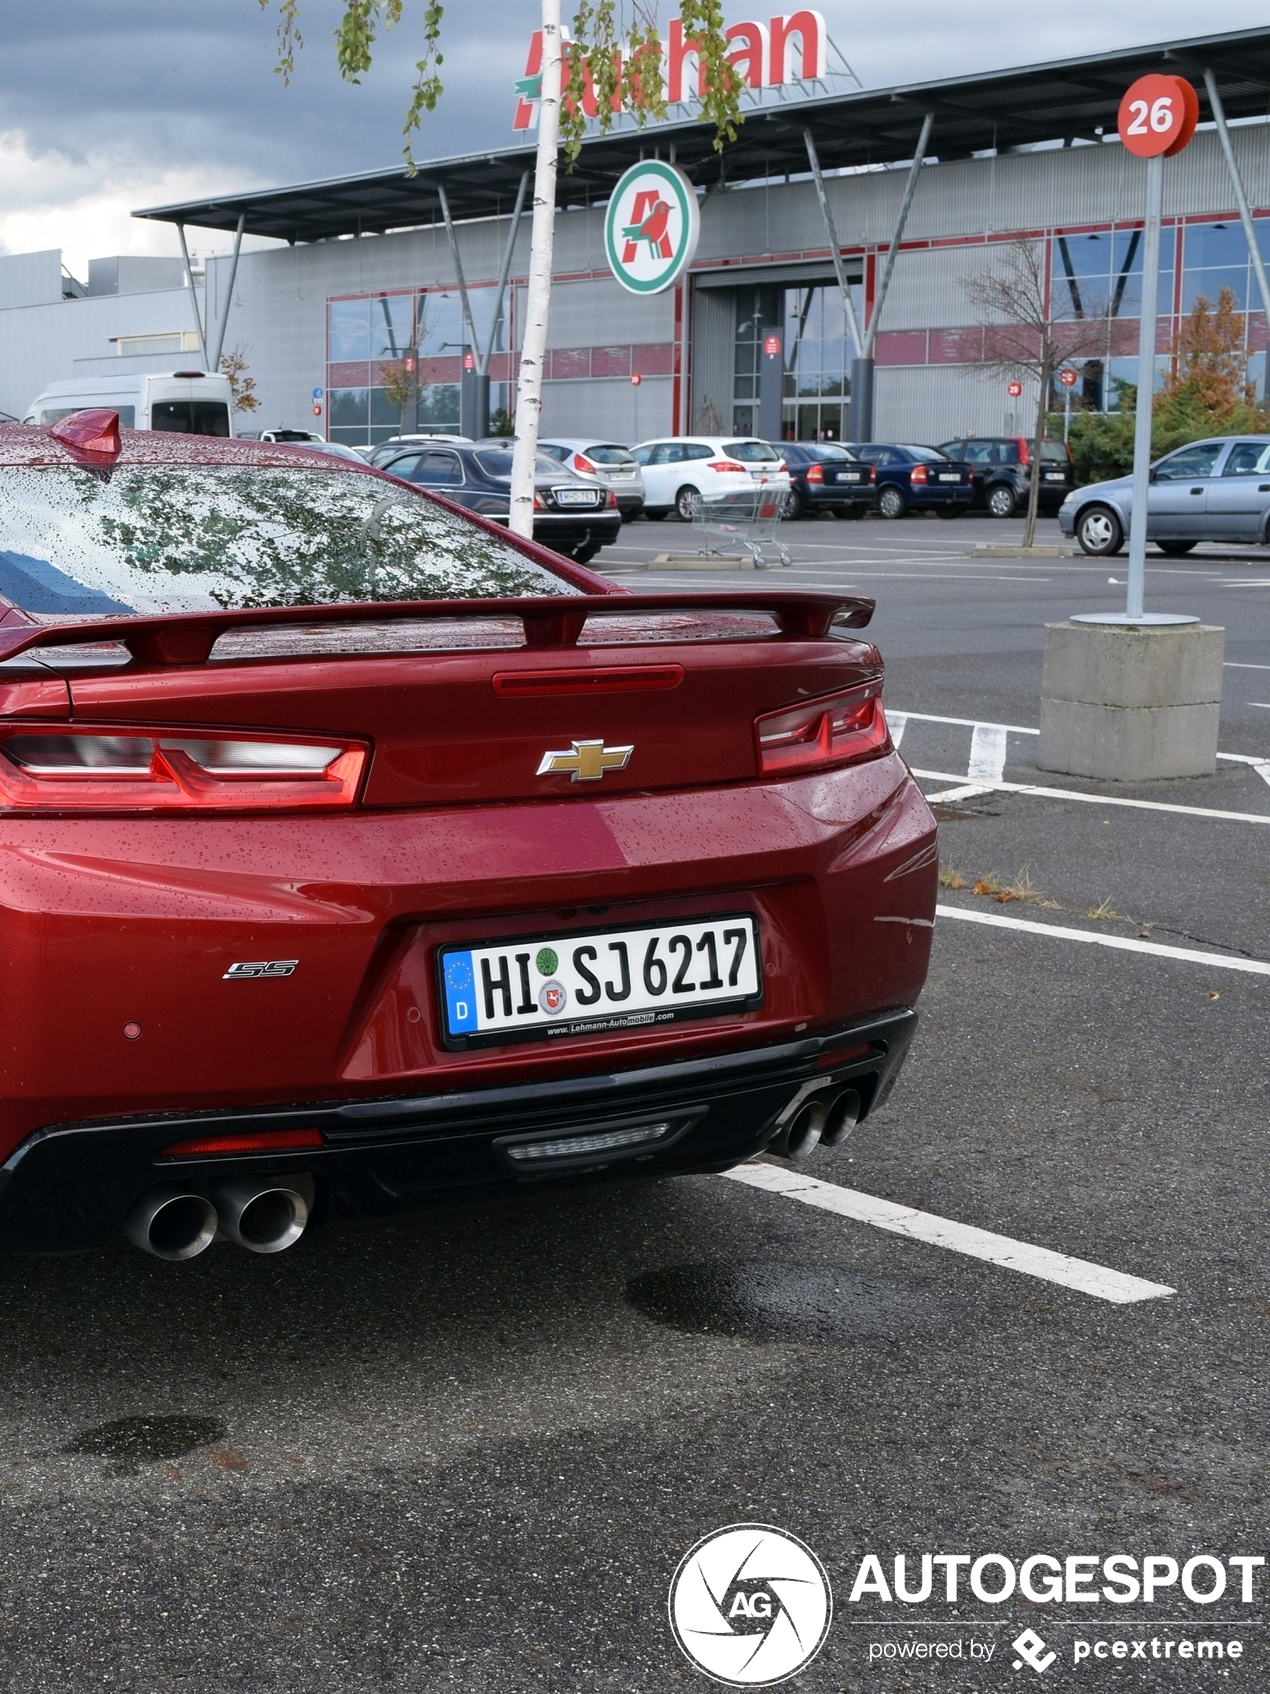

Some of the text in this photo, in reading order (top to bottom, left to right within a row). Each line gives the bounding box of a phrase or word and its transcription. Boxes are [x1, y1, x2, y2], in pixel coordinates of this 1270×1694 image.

[1126, 96, 1173, 135] 26
[222, 960, 299, 979] SS
[480, 953, 538, 1019] HI
[573, 941, 632, 1005] SJ
[643, 928, 748, 996] 6217
[456, 1001, 469, 1020] D
